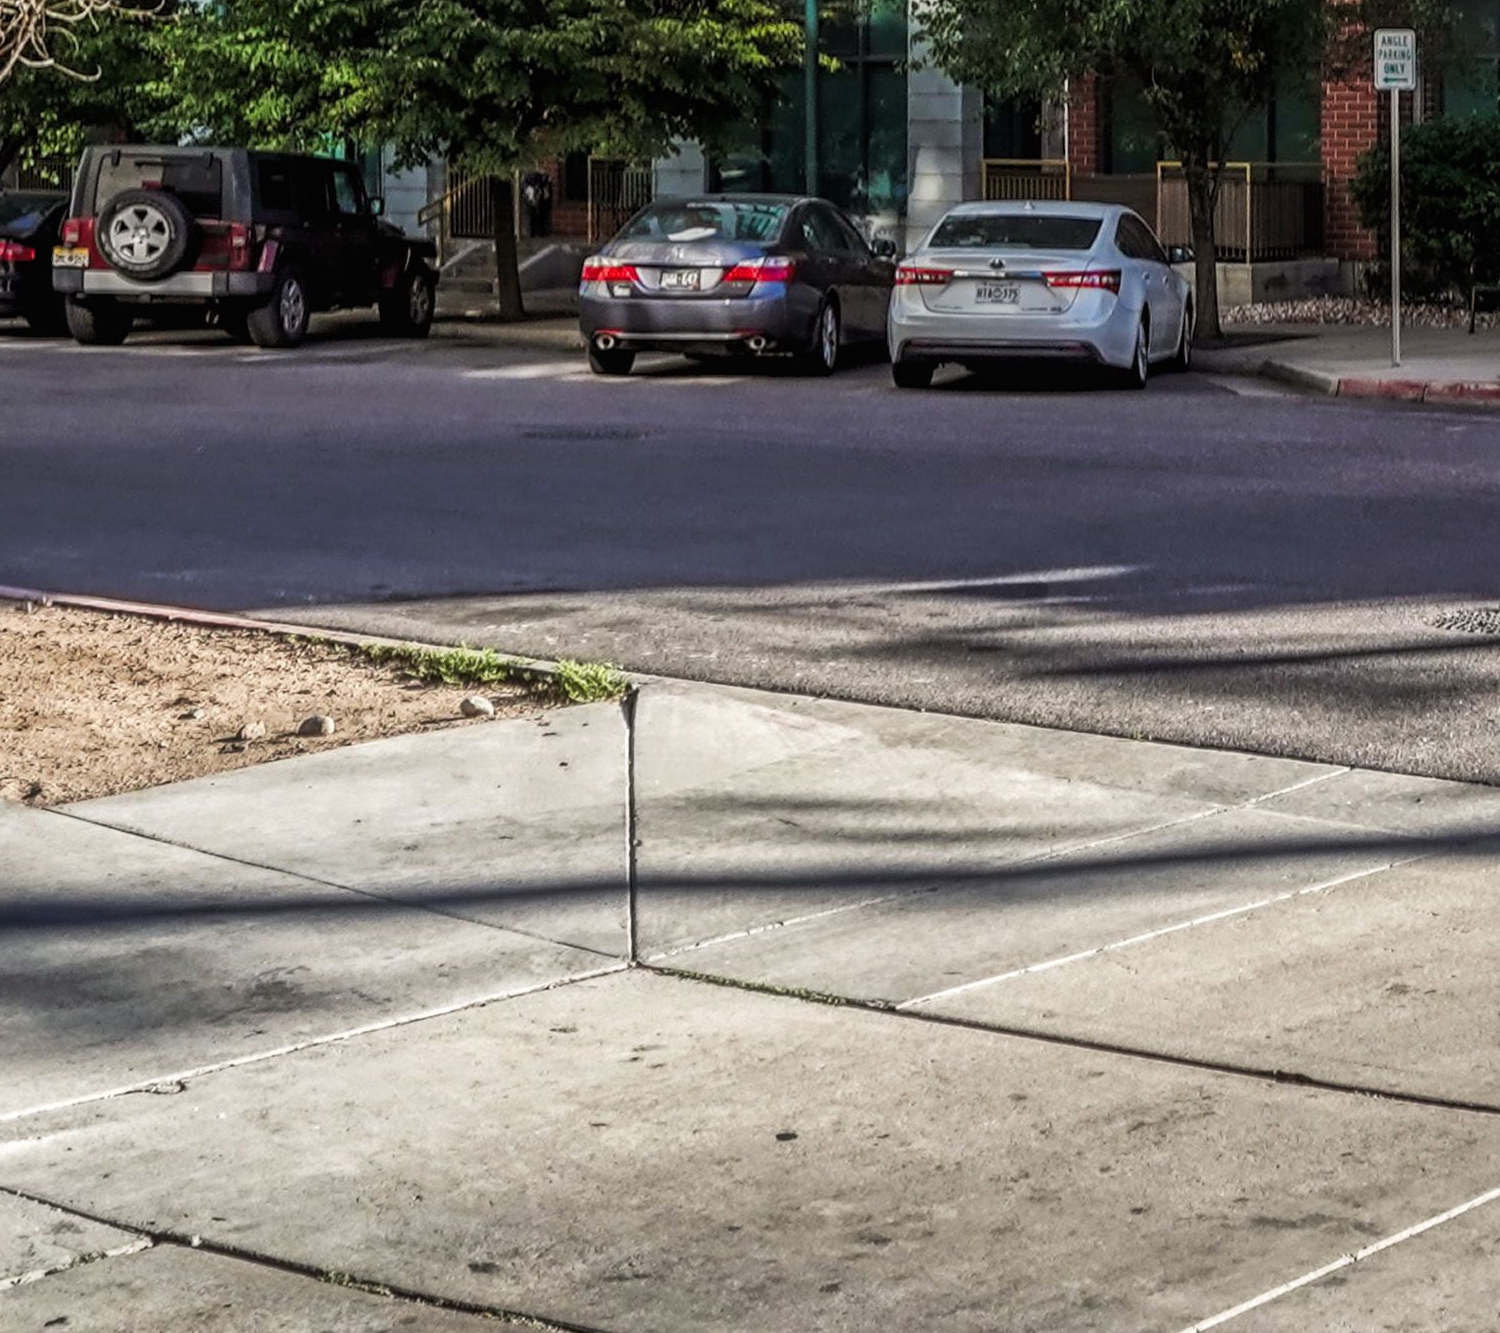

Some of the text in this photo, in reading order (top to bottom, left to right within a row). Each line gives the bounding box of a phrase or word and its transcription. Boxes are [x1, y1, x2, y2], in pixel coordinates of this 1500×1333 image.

[1381, 35, 1408, 47] ANGLE
[1379, 49, 1411, 61] PARKING
[1384, 62, 1405, 74] ONLY
